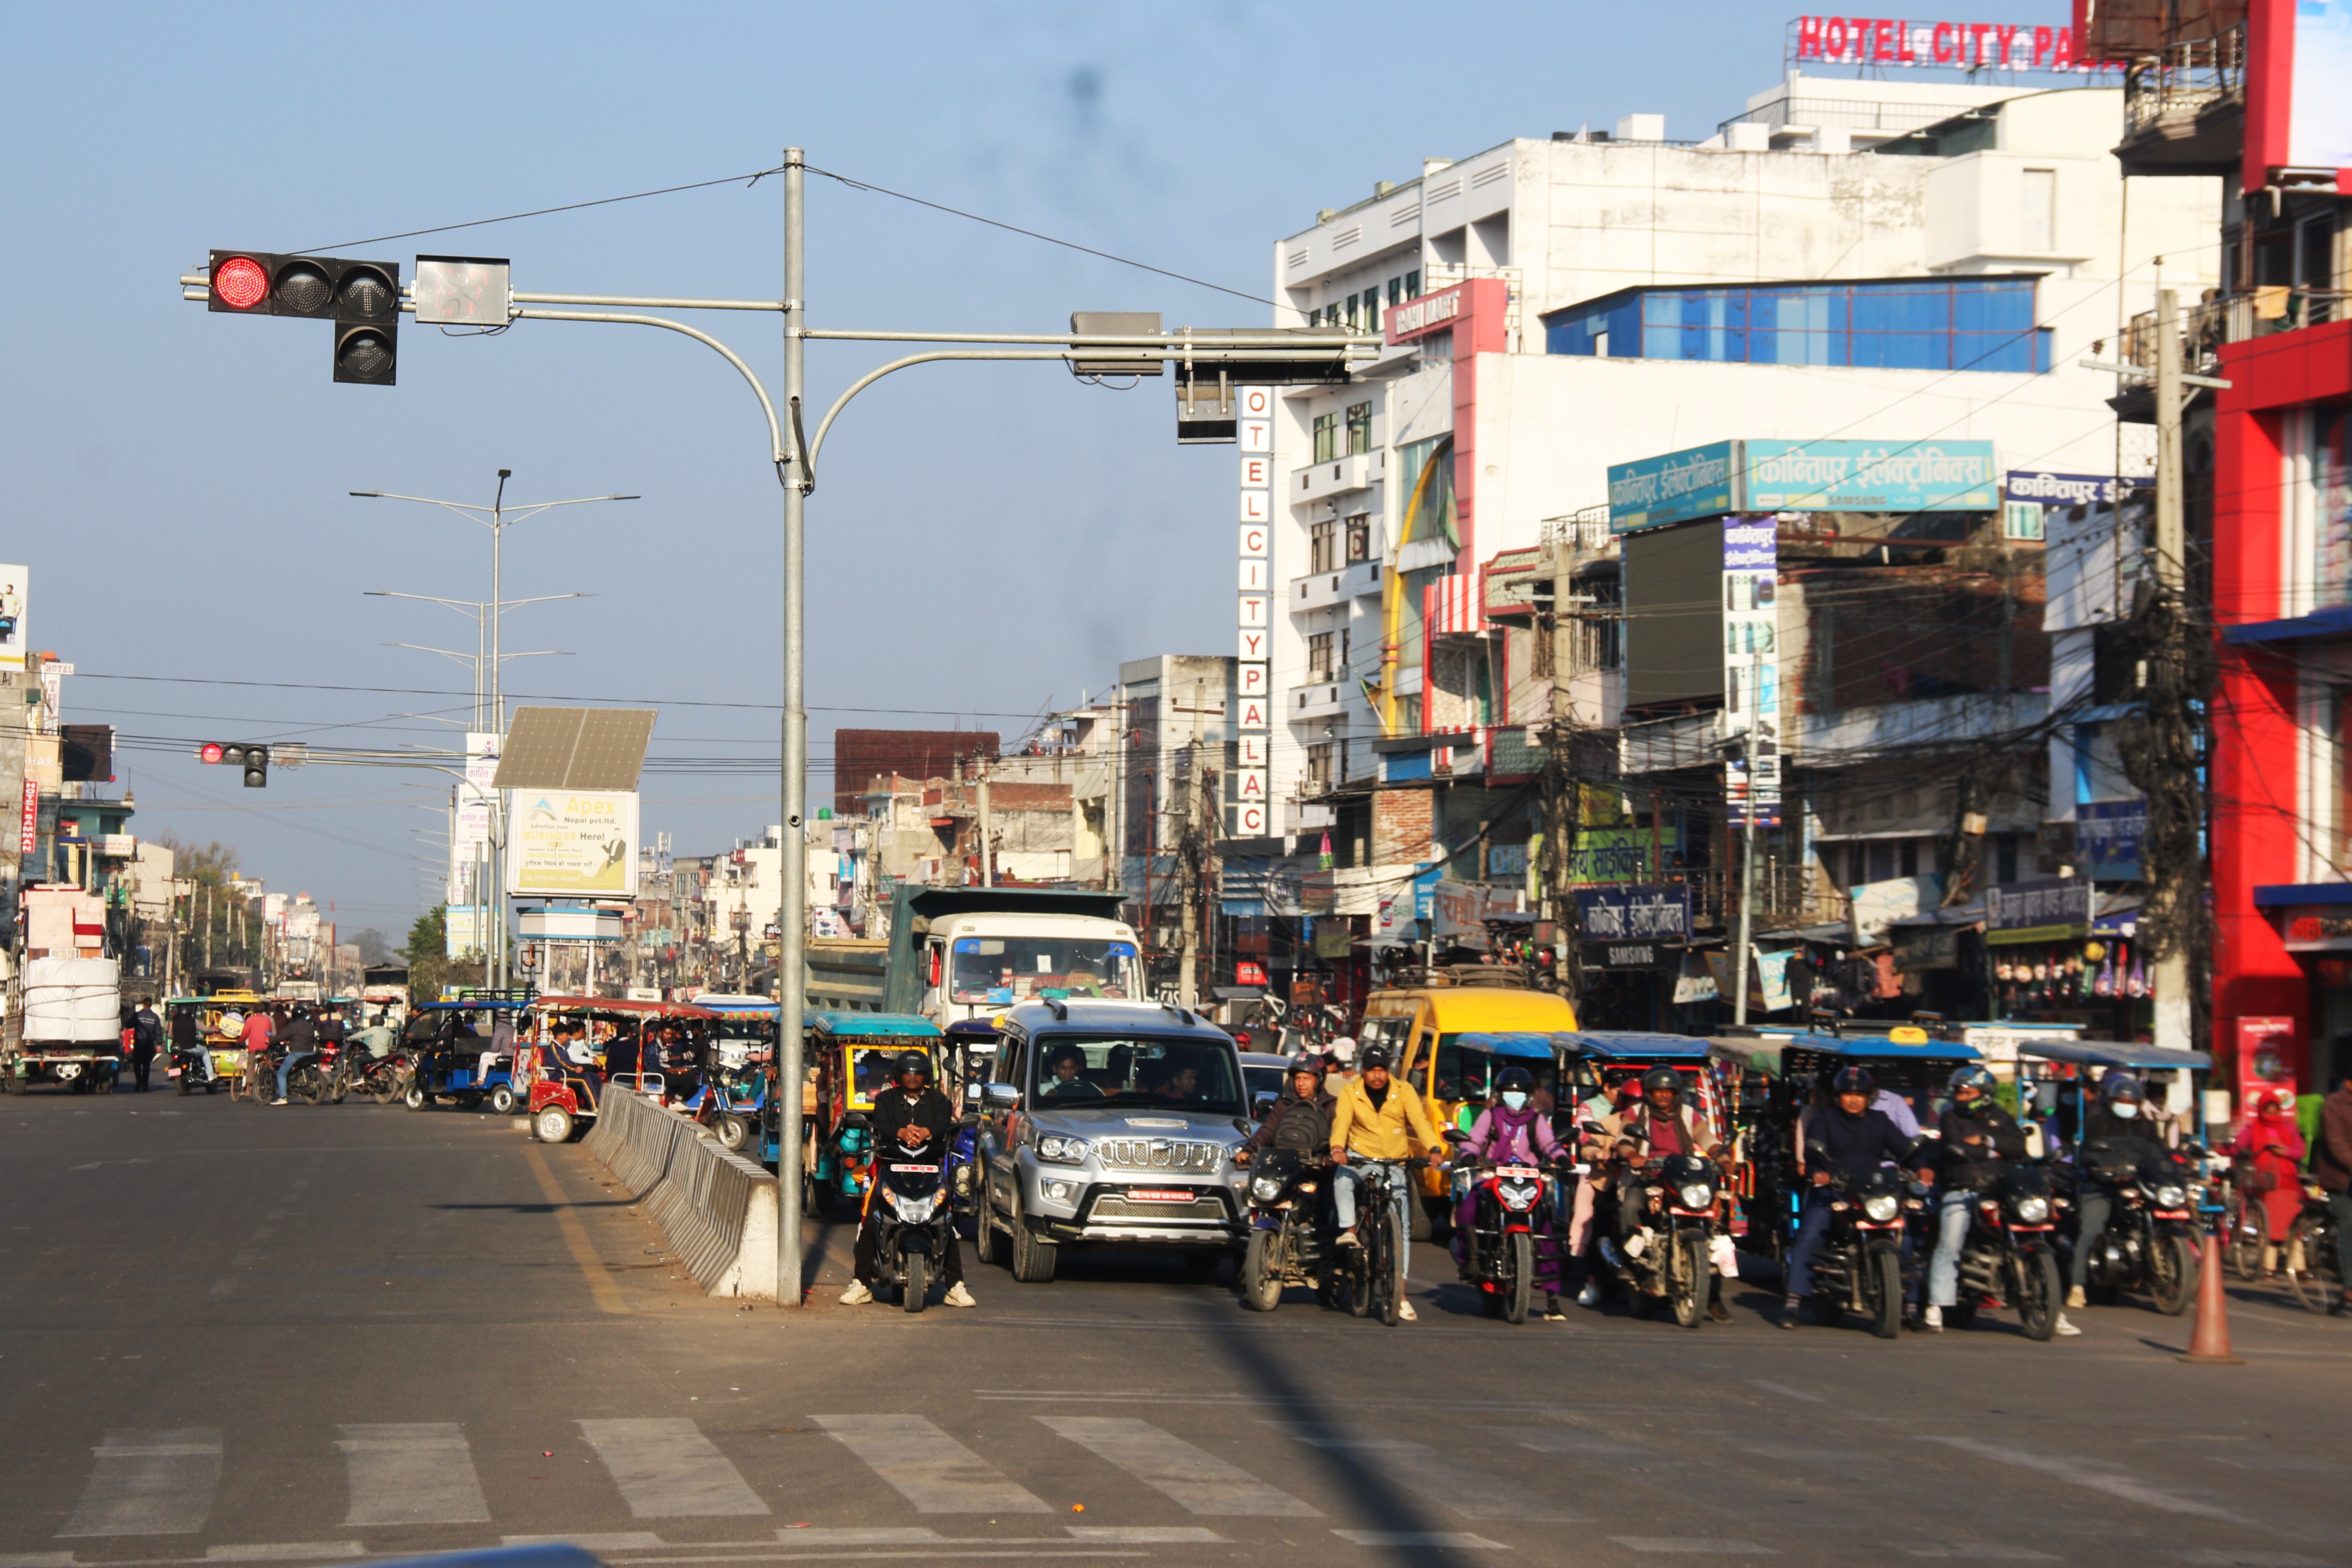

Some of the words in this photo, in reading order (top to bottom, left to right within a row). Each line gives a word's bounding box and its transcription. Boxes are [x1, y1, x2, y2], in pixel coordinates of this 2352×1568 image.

[1799, 16, 1914, 61] HOTEL
[1932, 22, 2017, 65] CITY
[1396, 303, 1424, 335] RAHI
[1426, 290, 1461, 325] MART
[1757, 447, 1851, 492] कान्तिपुर
[1613, 467, 1658, 509] कान्तिपुर
[1828, 495, 1887, 506] SAMSUNG
[2009, 473, 2100, 505] कान्तिपुर
[1724, 524, 1776, 548] कान्तिपुर
[46, 664, 74, 674] HOTEL
[468, 767, 490, 778] कान्ति
[26, 782, 36, 812] HOTEL
[566, 796, 616, 818] Apex
[22, 814, 34, 851] SAMMAN
[524, 831, 577, 841] BUSINESS
[580, 832, 605, 841] Here!
[1609, 945, 1654, 965] SAMSUNG
